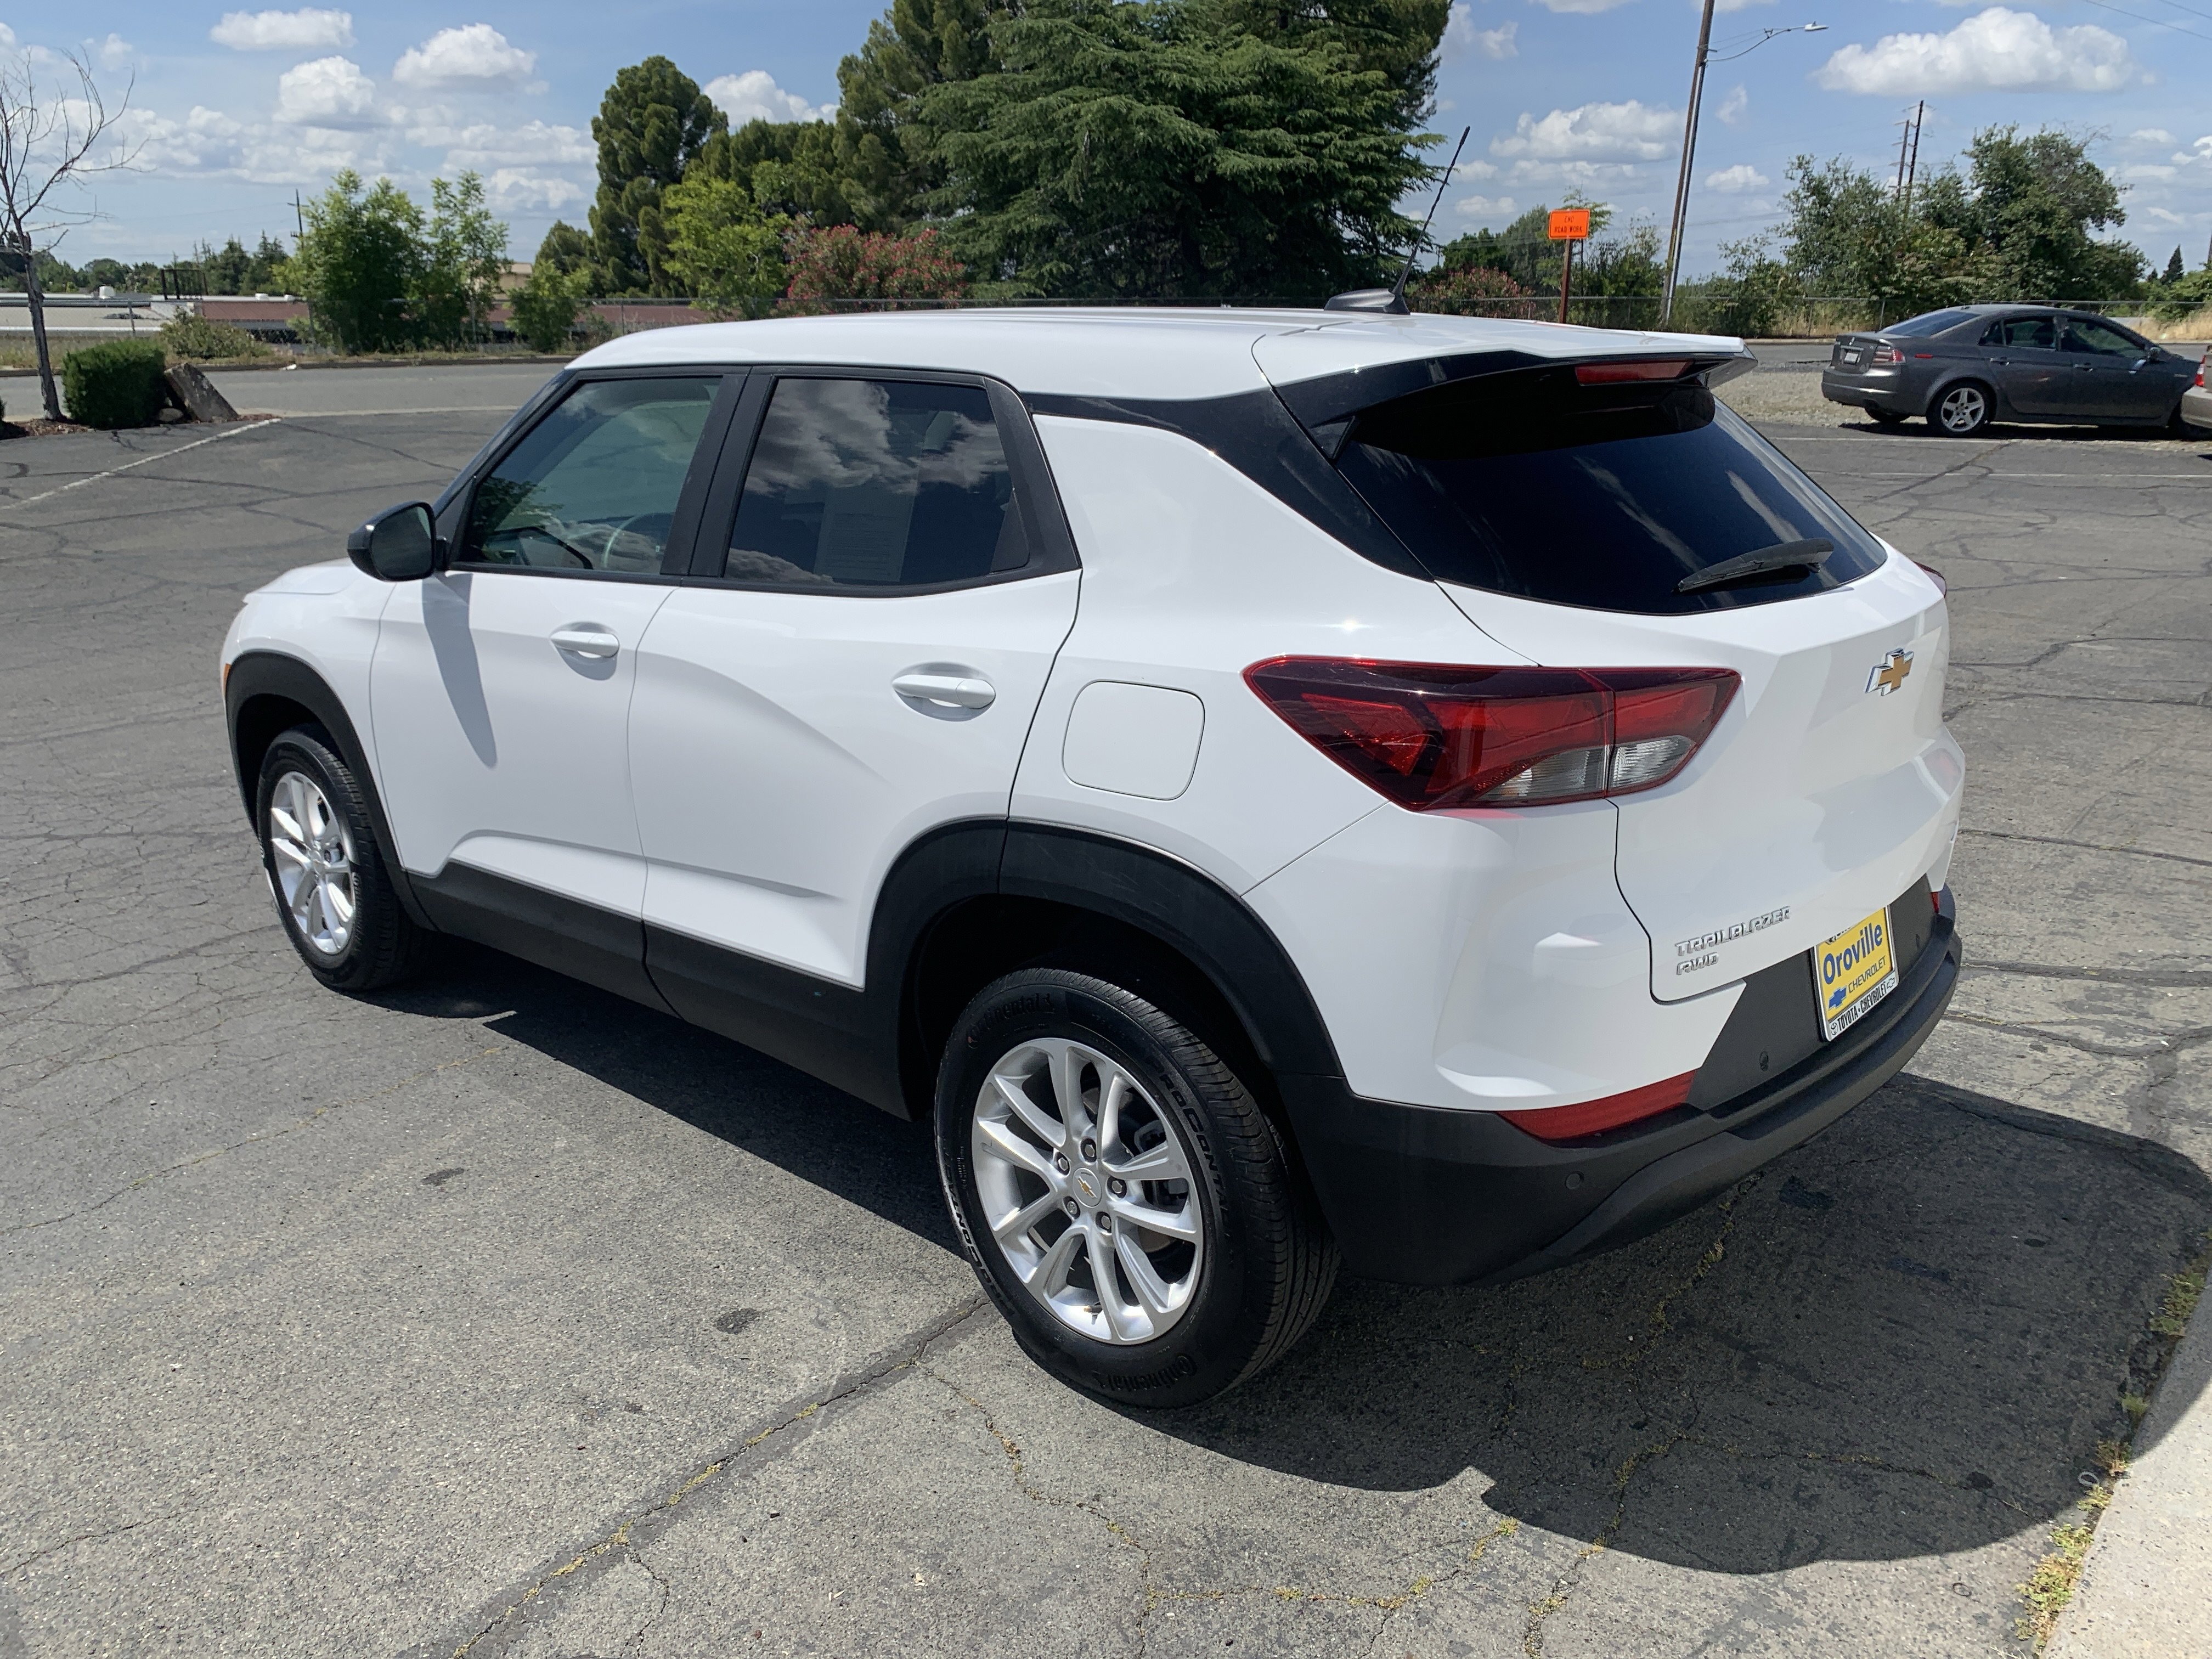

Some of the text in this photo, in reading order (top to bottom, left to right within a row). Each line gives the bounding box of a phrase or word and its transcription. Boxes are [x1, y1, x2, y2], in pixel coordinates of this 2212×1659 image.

[1674, 906, 1791, 956] TRAILBLAZER
[1823, 923, 1882, 984] Oroville
[1676, 951, 1719, 975] AWD
[1848, 956, 1886, 994] CHEVROLET
[1837, 981, 1887, 1031] TOYOTA CHEVROLET
